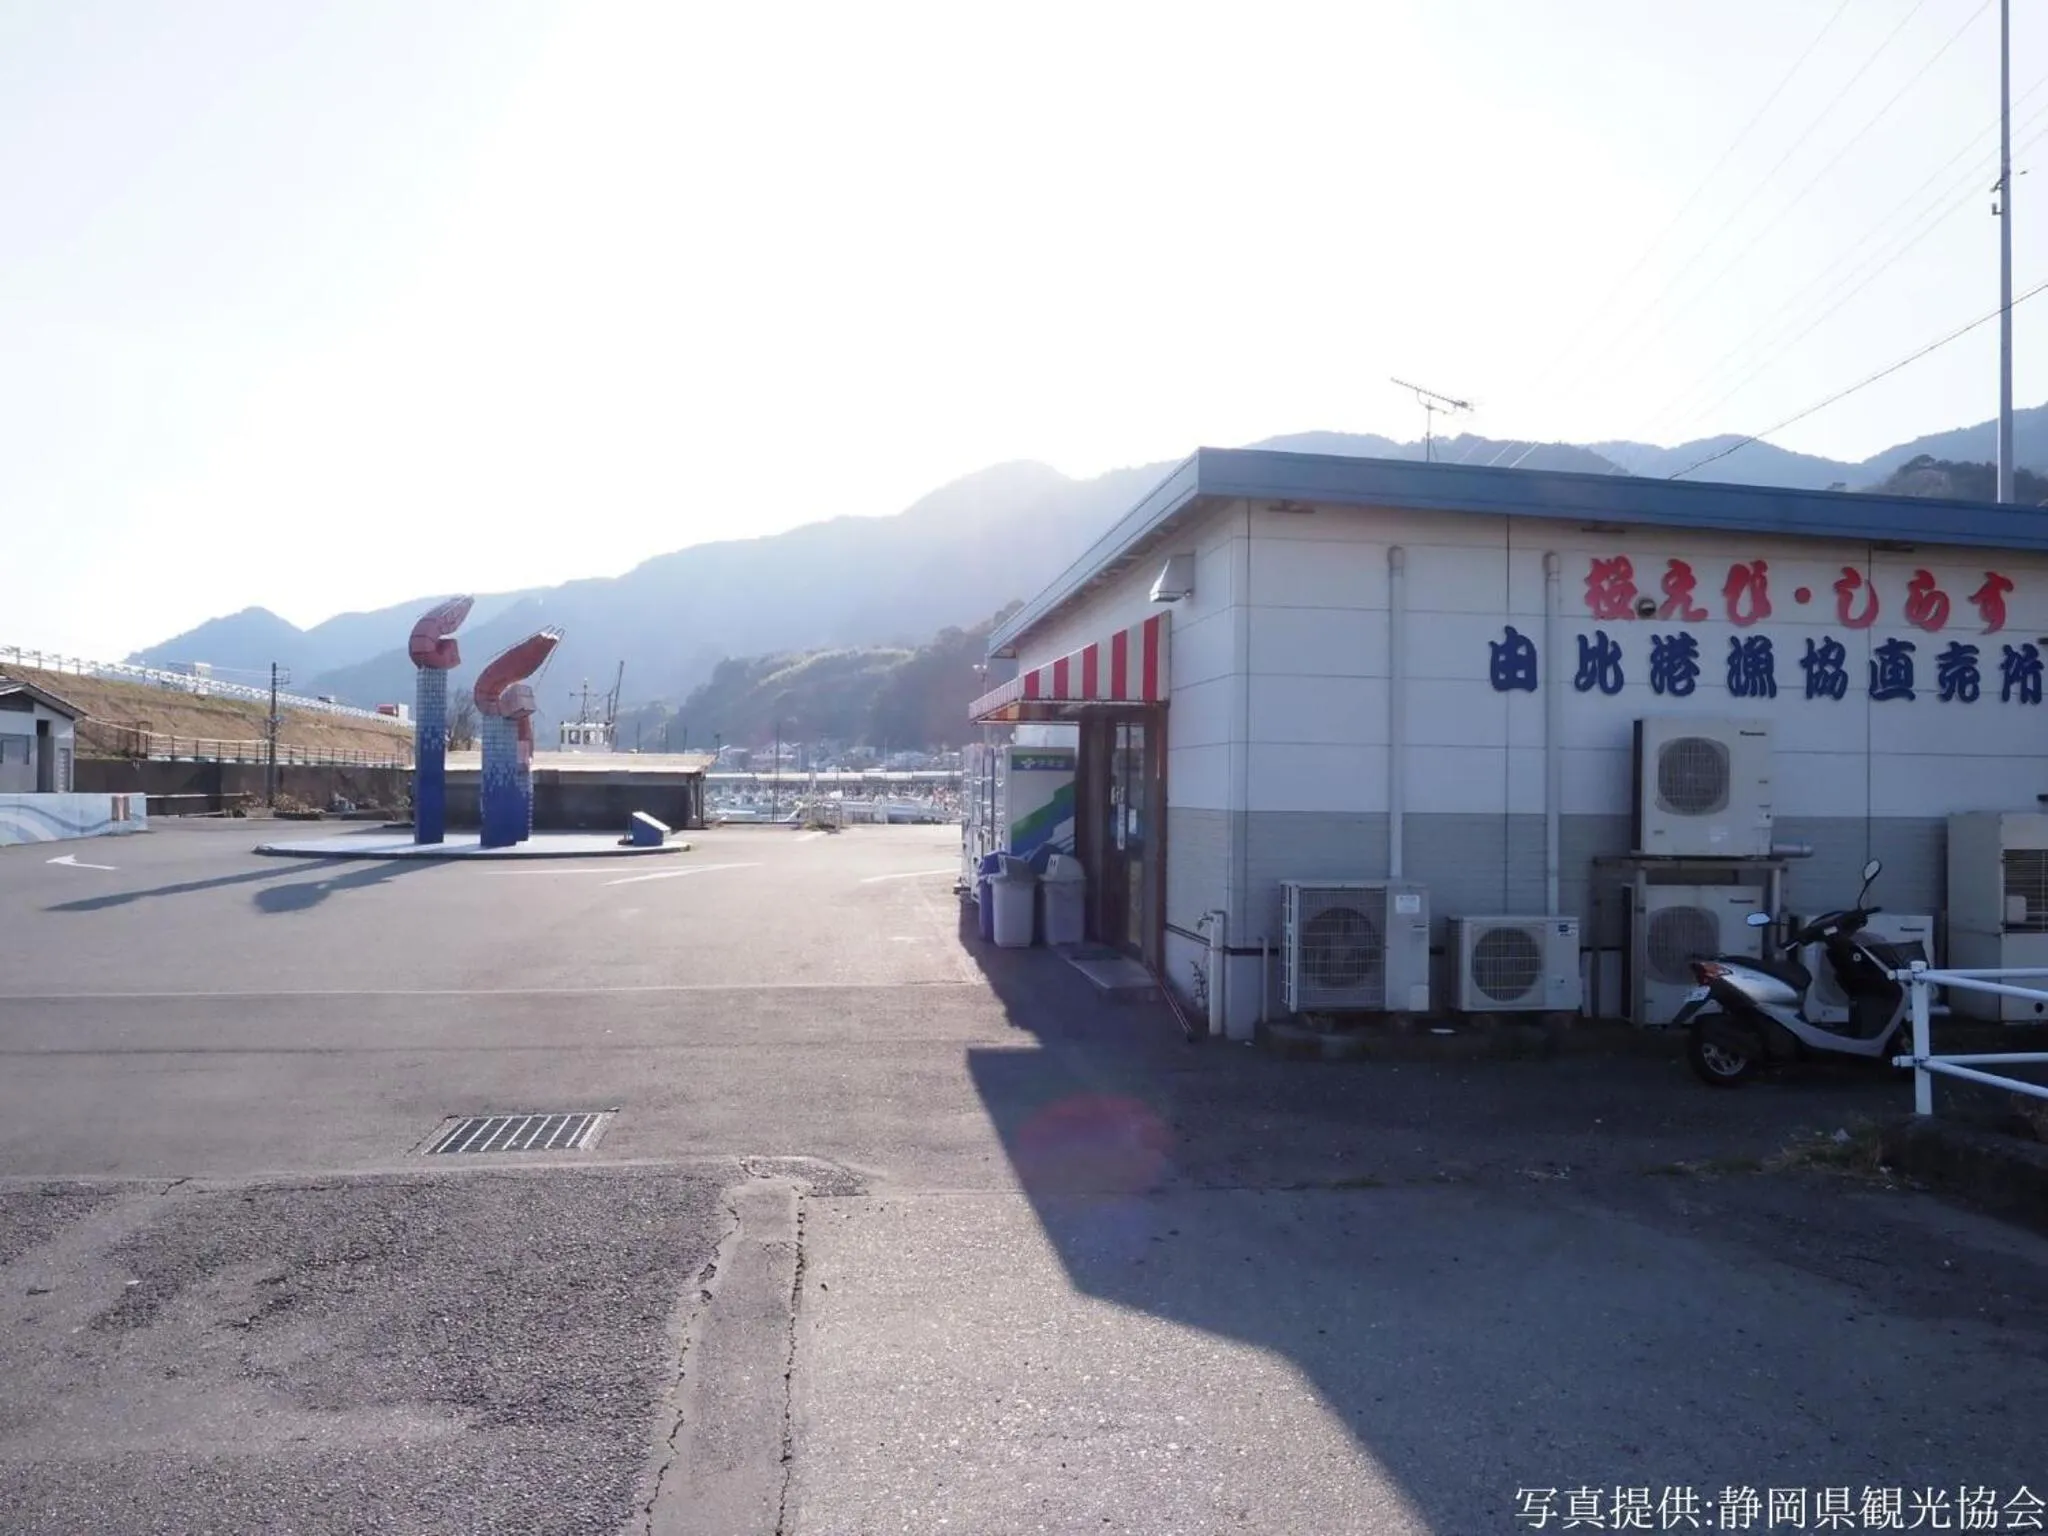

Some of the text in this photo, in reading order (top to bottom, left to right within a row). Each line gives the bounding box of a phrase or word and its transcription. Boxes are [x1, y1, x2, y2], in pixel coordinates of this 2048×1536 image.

[1488, 625, 2046, 704] 由比港漁協直売所
